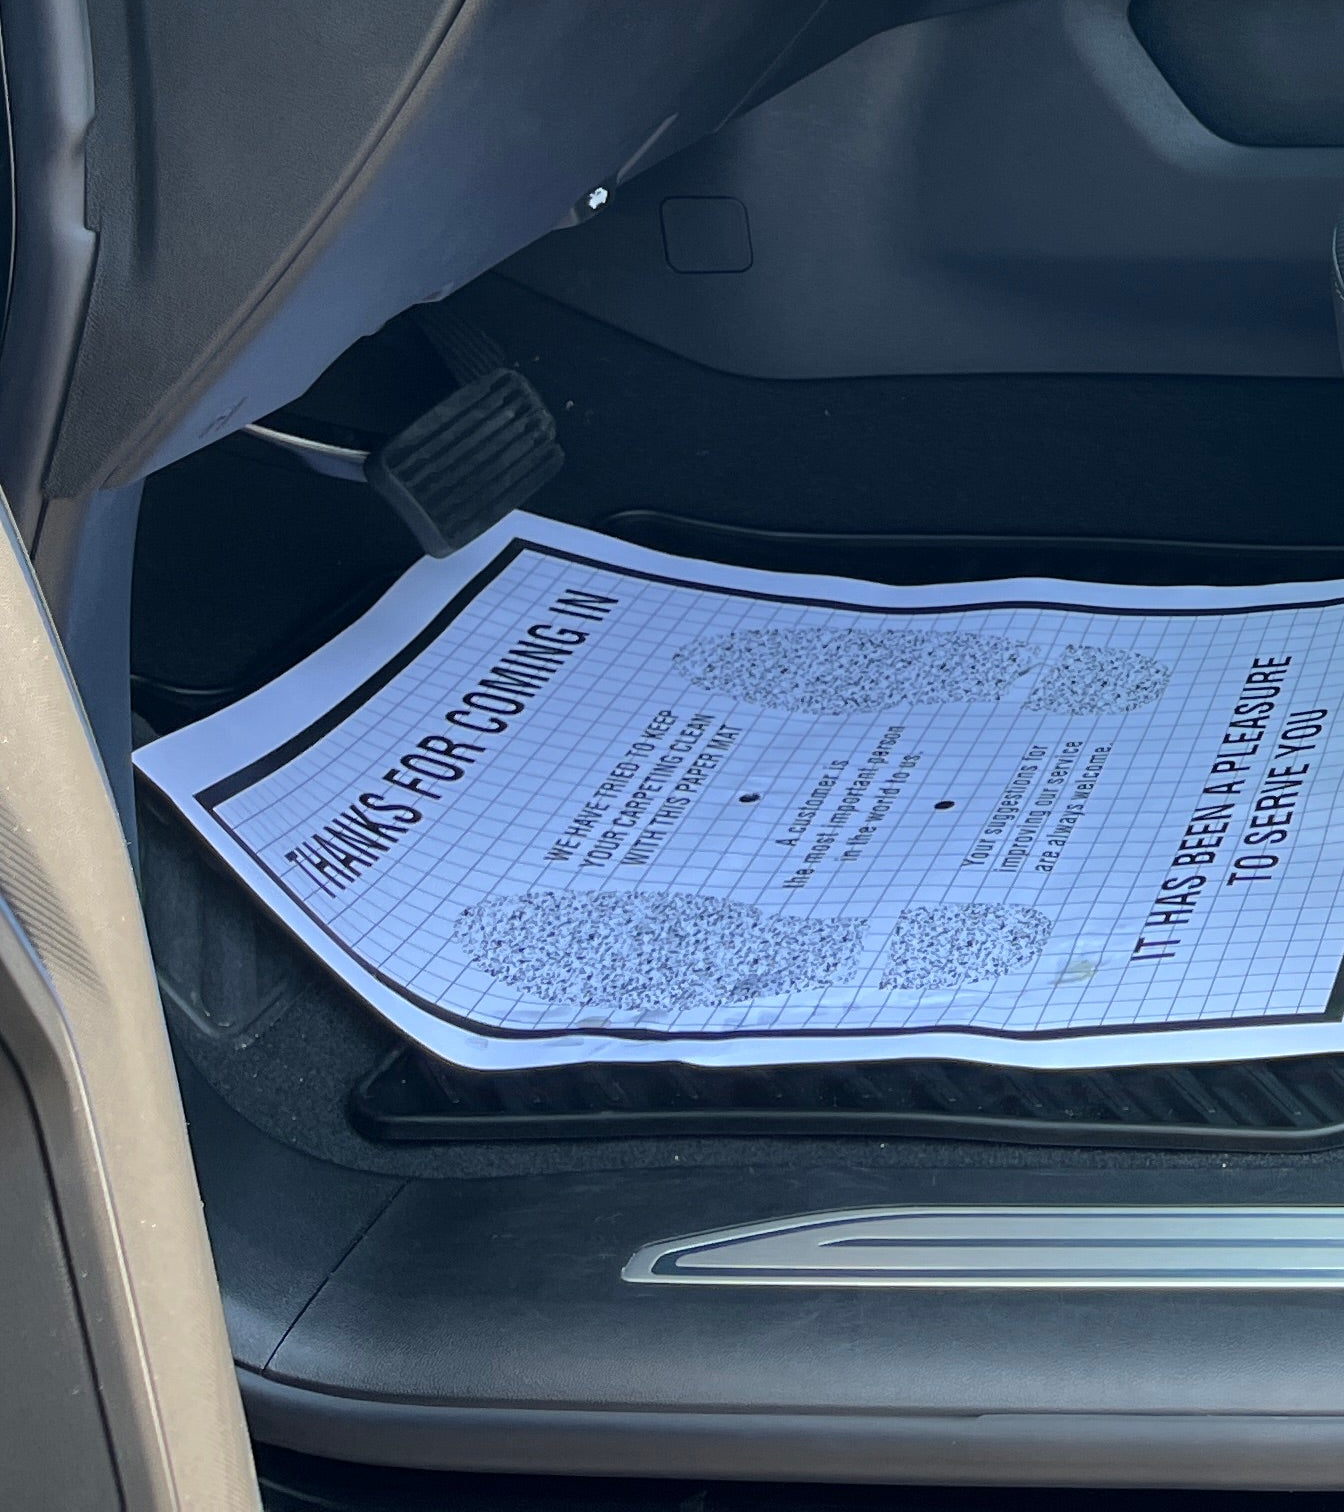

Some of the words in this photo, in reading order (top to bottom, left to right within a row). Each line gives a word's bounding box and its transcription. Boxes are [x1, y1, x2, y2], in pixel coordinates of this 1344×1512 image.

[284, 792, 423, 898] THANKS
[382, 735, 486, 800] FOR
[445, 624, 590, 734] COMING
[548, 589, 619, 621] IN
[1210, 655, 1293, 774] PLEASURE
[1274, 707, 1329, 760] YOU
[543, 838, 580, 861] WE
[564, 801, 611, 838] HAVE
[593, 761, 640, 799] TRIED
[625, 742, 655, 758] TO
[640, 710, 678, 740] KEEP
[578, 830, 628, 868] YOUR
[612, 754, 684, 828] CARPETING
[669, 713, 716, 753] CLEAN
[620, 829, 667, 866] WITH
[649, 796, 691, 826] THIS
[675, 752, 723, 793] PAPER
[706, 723, 743, 751] MAT
[885, 771, 910, 783] to
[1071, 742, 1114, 800] welcome.
[1202, 778, 1246, 795] A
[775, 837, 800, 847] A
[788, 774, 840, 833] customer
[823, 759, 849, 771] is
[782, 868, 815, 888] the
[803, 832, 839, 864] most
[821, 767, 879, 828] important
[867, 725, 906, 764] person
[866, 787, 901, 822] world
[961, 838, 996, 867] Your
[984, 765, 1038, 835] suggestions
[1022, 745, 1048, 761] for
[993, 810, 1051, 872] improving
[1035, 787, 1059, 807] our
[1047, 741, 1083, 785] service
[1046, 803, 1086, 847] always
[1243, 762, 1311, 845] SERVE
[834, 849, 863, 861] in
[846, 825, 877, 846] the
[1035, 851, 1060, 872] are
[1171, 803, 1236, 868] BEEN
[1226, 854, 1280, 887] TO
[1144, 873, 1207, 927] HAS
[1130, 936, 1182, 962] IT
